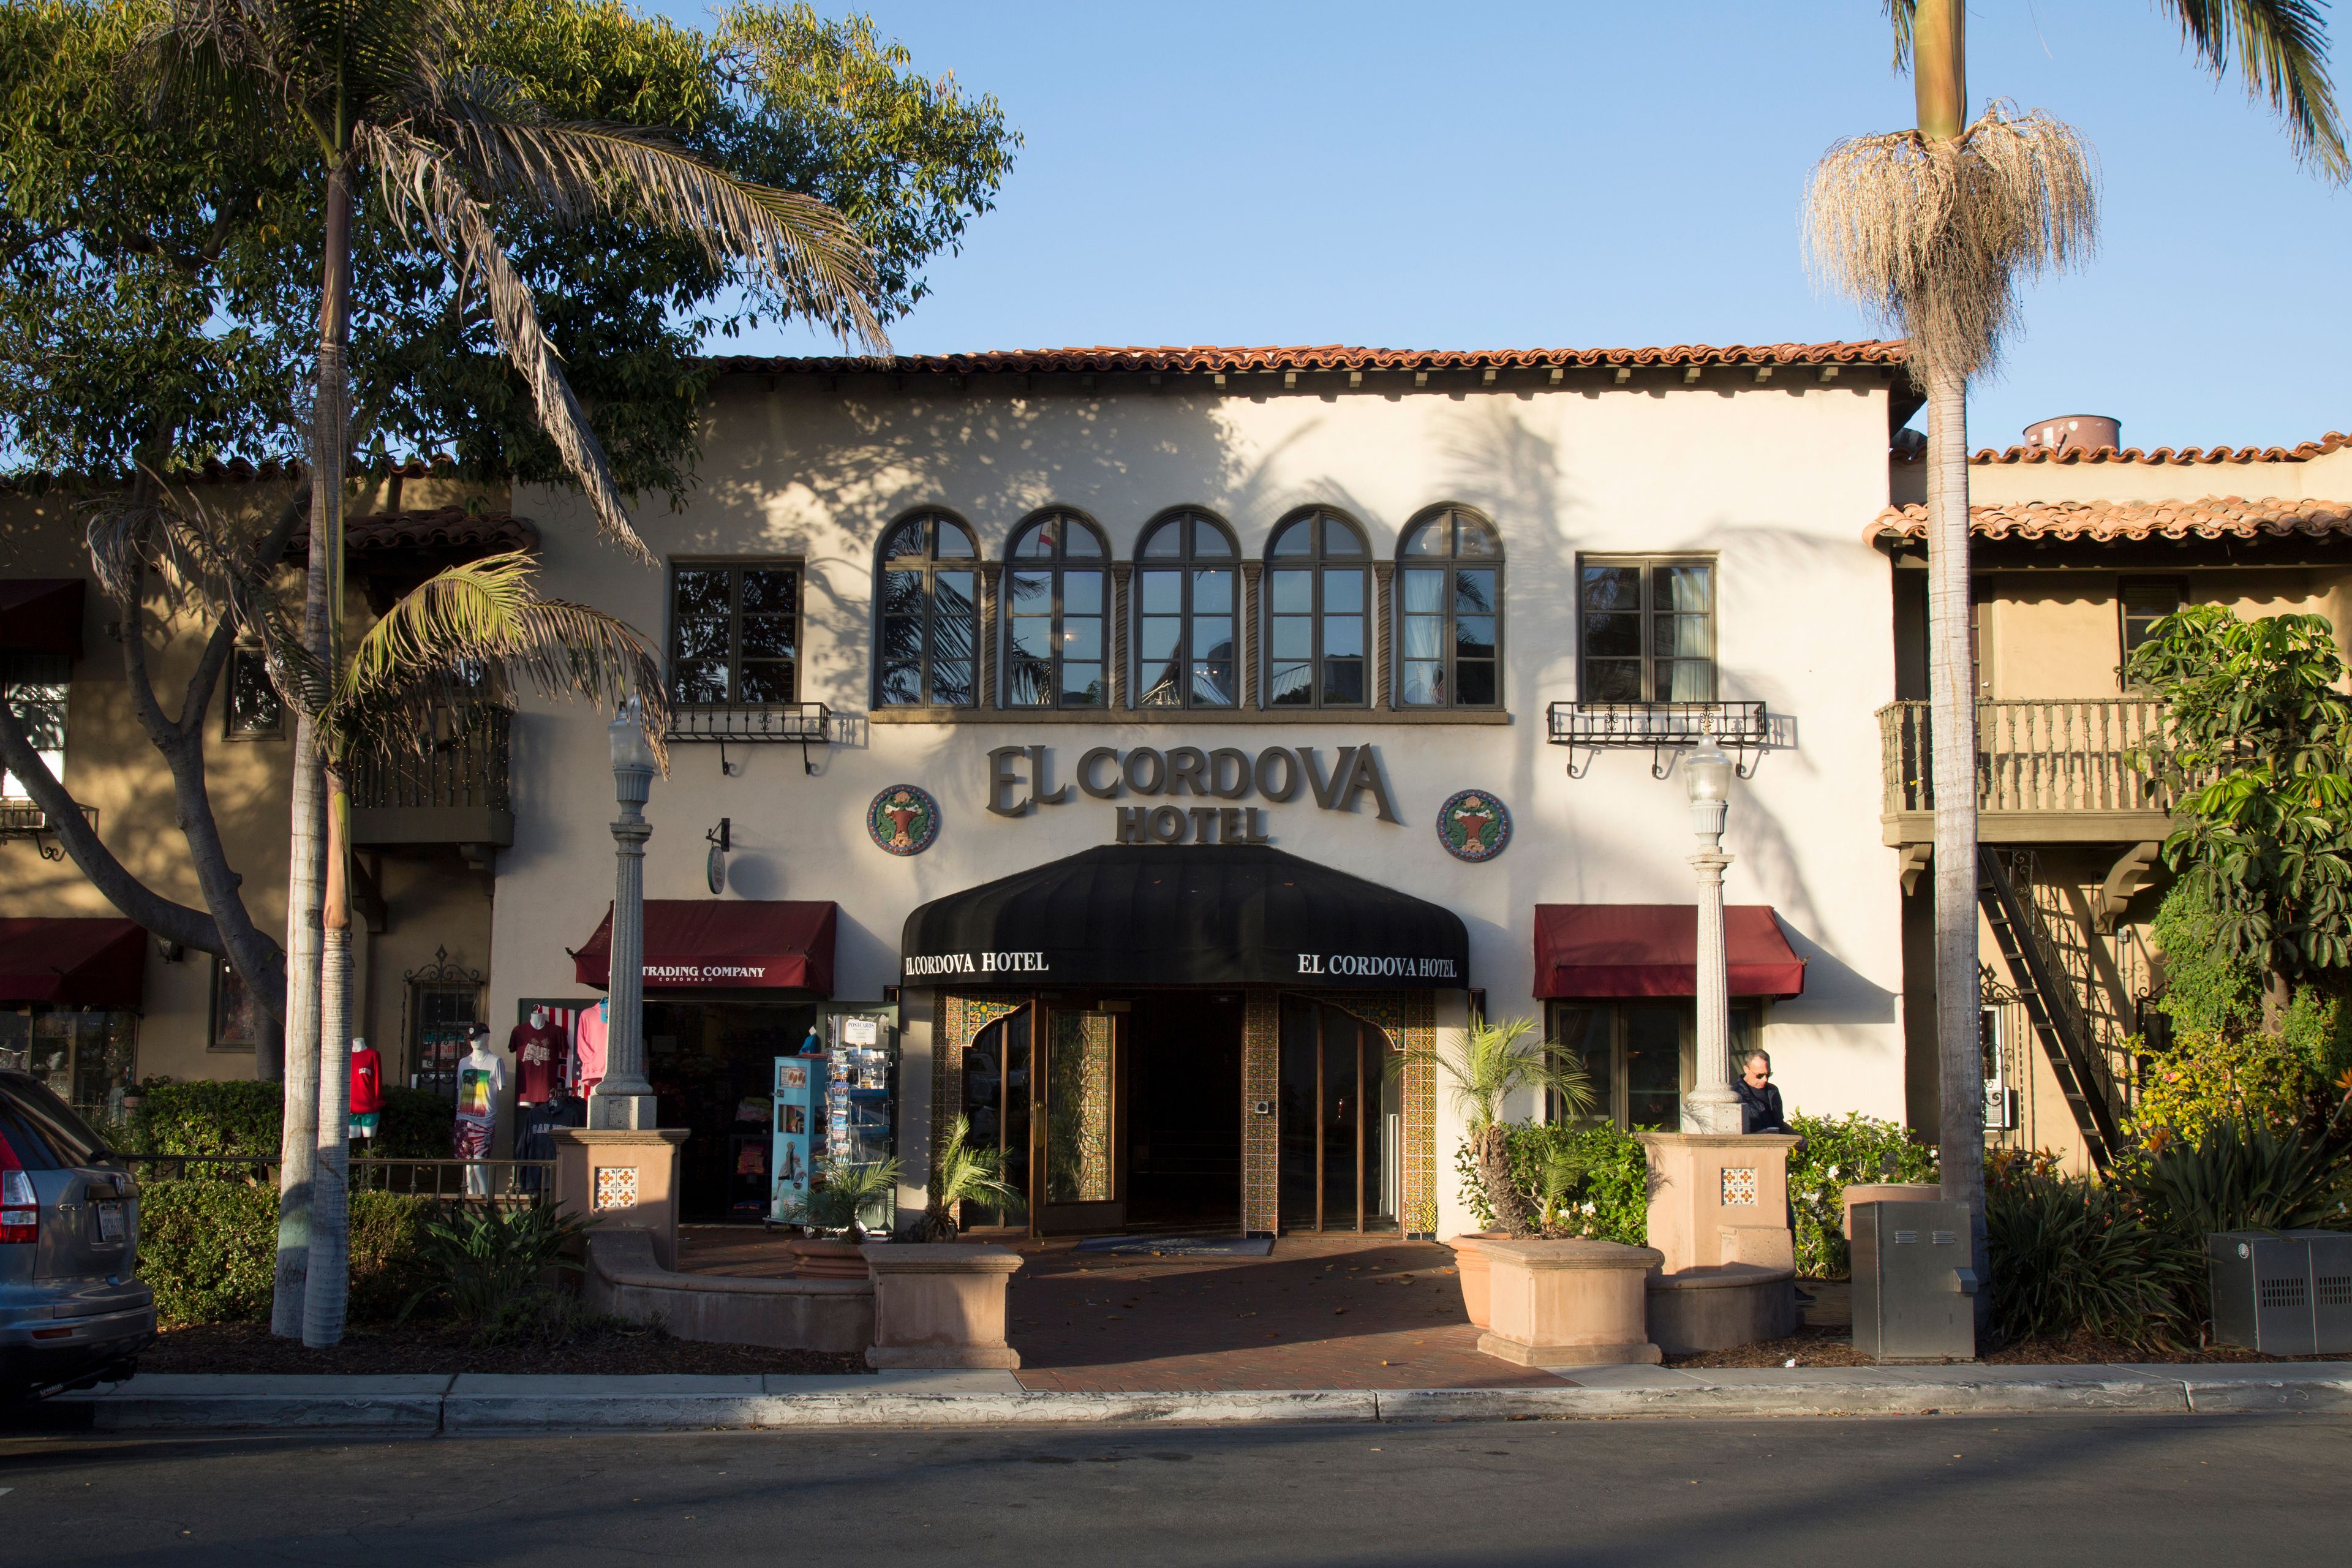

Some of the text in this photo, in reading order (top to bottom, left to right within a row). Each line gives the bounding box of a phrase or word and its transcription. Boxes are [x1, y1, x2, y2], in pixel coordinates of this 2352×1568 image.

[986, 742, 1401, 825] EL CORDOVA
[1115, 805, 1270, 843] HOTEL
[643, 967, 766, 978] TRADING COMPANY
[906, 952, 1049, 975] EL CORDOVA HOTEL
[1297, 954, 1457, 978] EL CORDOVA HOTEL
